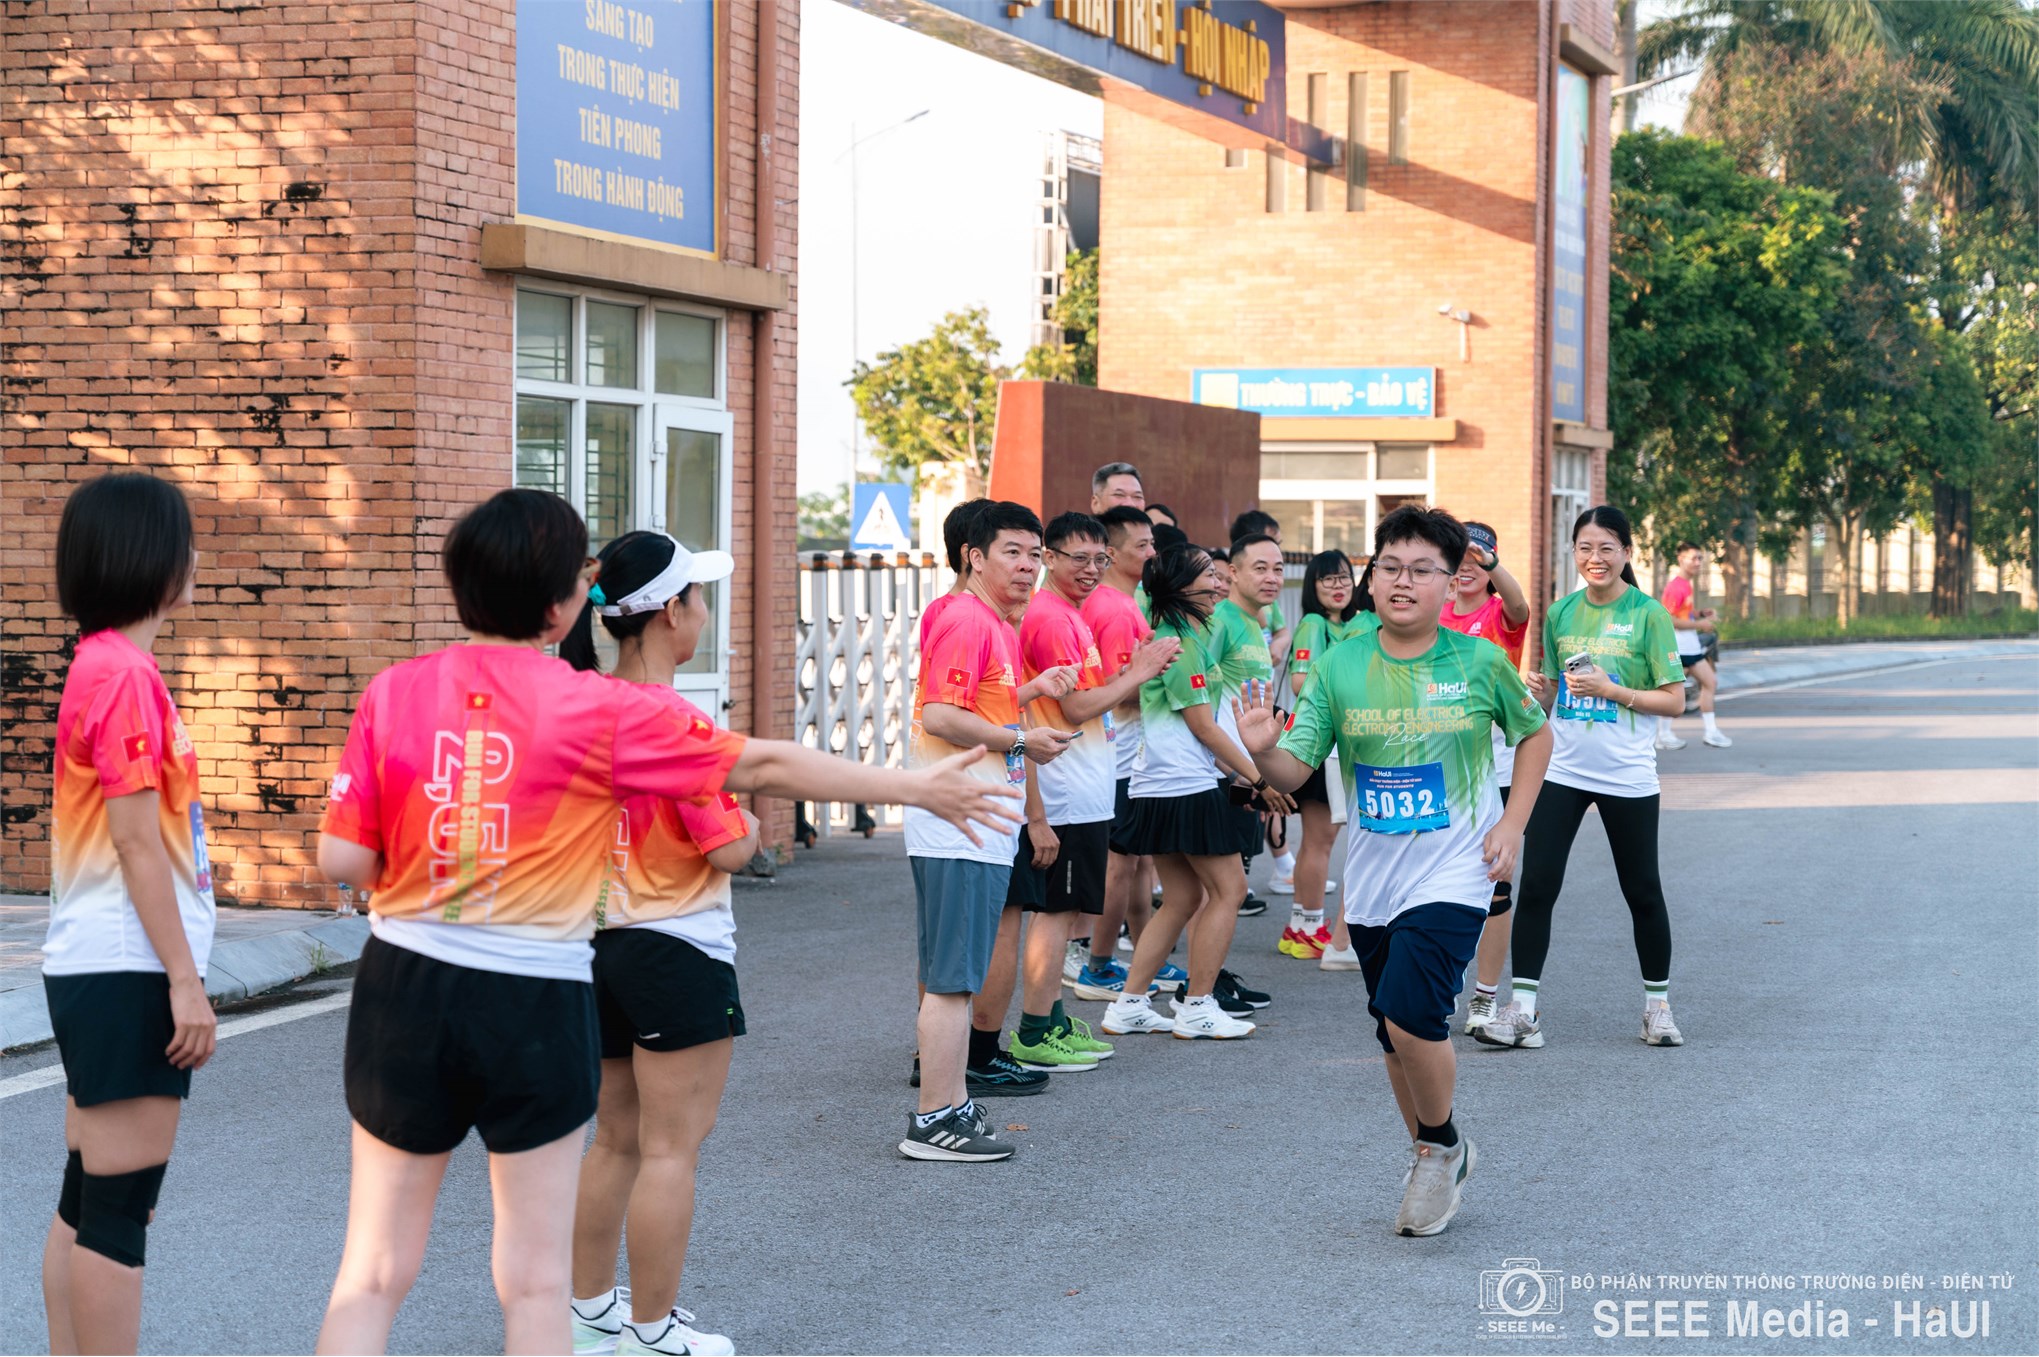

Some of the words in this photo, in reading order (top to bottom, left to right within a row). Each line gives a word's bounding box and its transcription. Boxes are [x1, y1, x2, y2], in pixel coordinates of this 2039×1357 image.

[628, 9, 654, 53] TẠO
[557, 43, 606, 91] TRONG
[609, 60, 645, 105] THỰC
[648, 68, 680, 115] HIỆN
[1221, 19, 1271, 115] NHẬP
[579, 104, 611, 148] TIÊN
[615, 117, 662, 160] PHONG
[554, 158, 602, 202] TRONG
[606, 166, 644, 211] HÀNH
[647, 176, 684, 222] ĐỘNG
[1344, 708, 1385, 722] SCHOOL
[1387, 708, 1402, 721] OF
[1403, 706, 1466, 721] ELECTRICAL
[1382, 722, 1428, 750] Race
[1365, 789, 1435, 818] 5032
